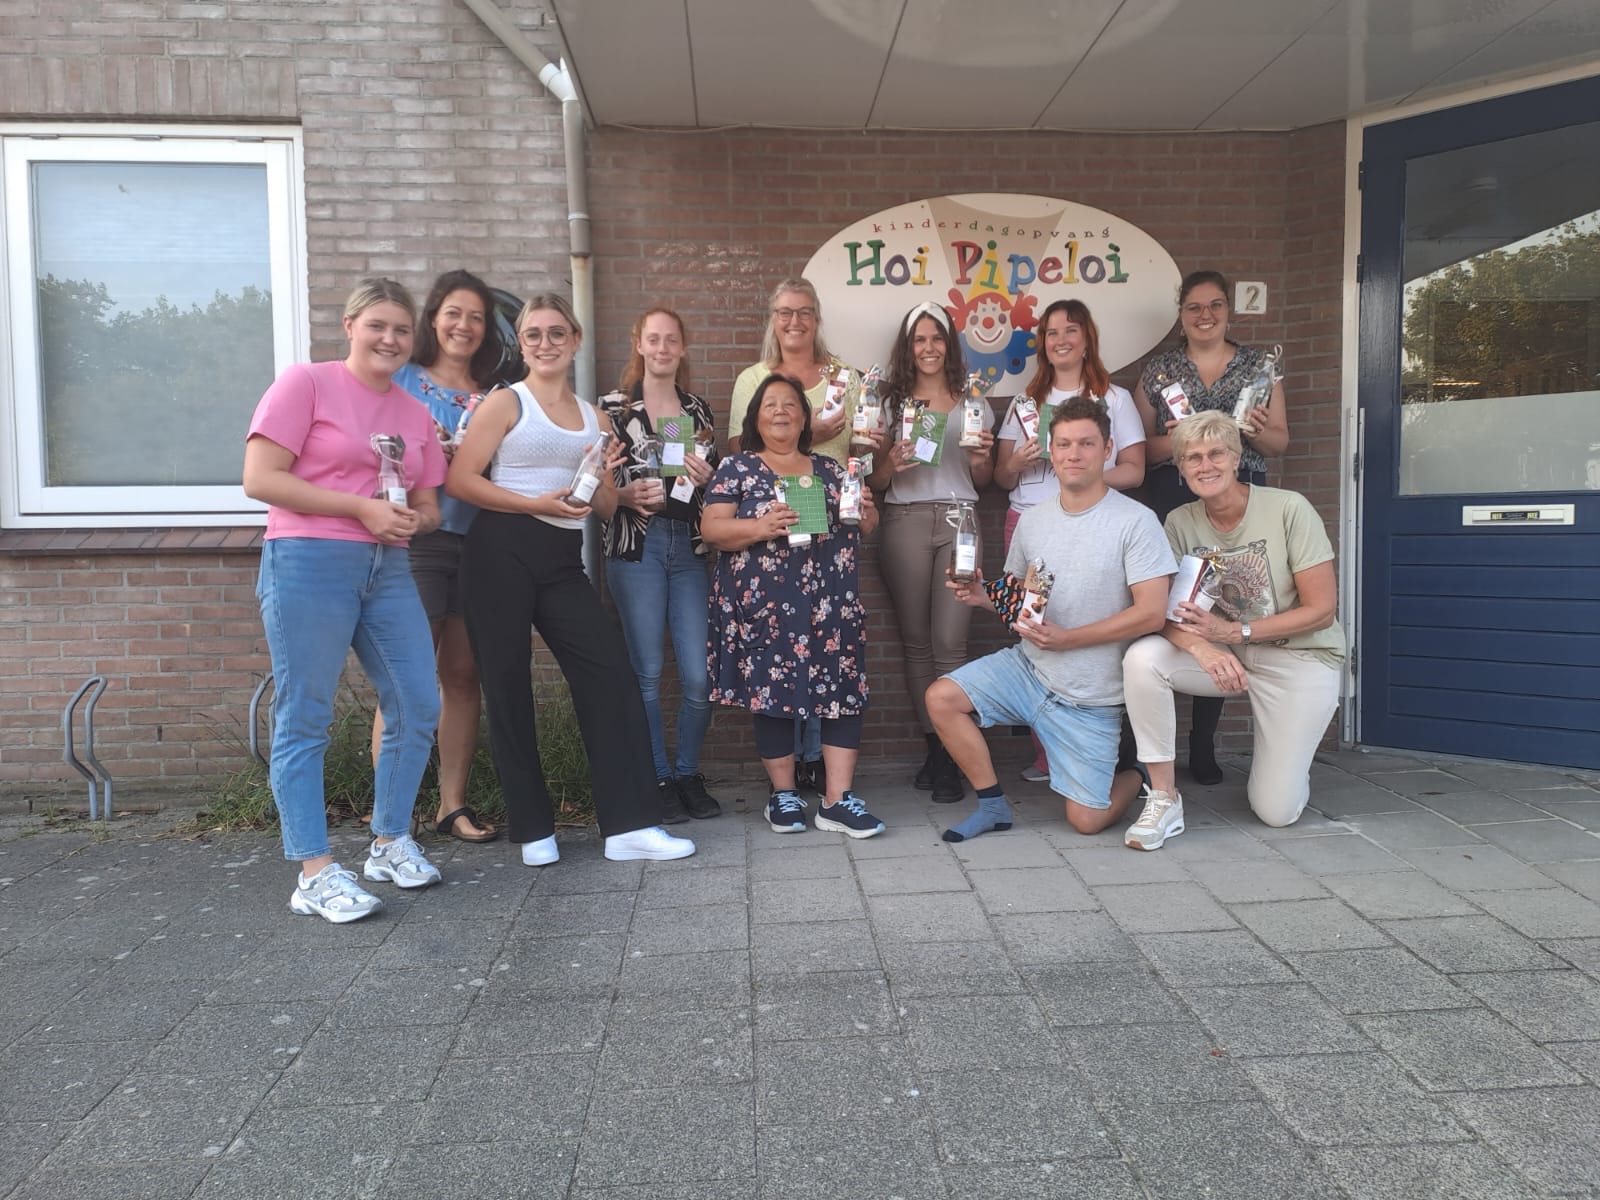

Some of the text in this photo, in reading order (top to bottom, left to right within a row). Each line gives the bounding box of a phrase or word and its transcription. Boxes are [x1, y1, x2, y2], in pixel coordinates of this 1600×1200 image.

[872, 218, 1111, 240] kinderdagopvang
[843, 239, 1130, 295] Hoi Pipeloi
[1245, 285, 1260, 311] 2
